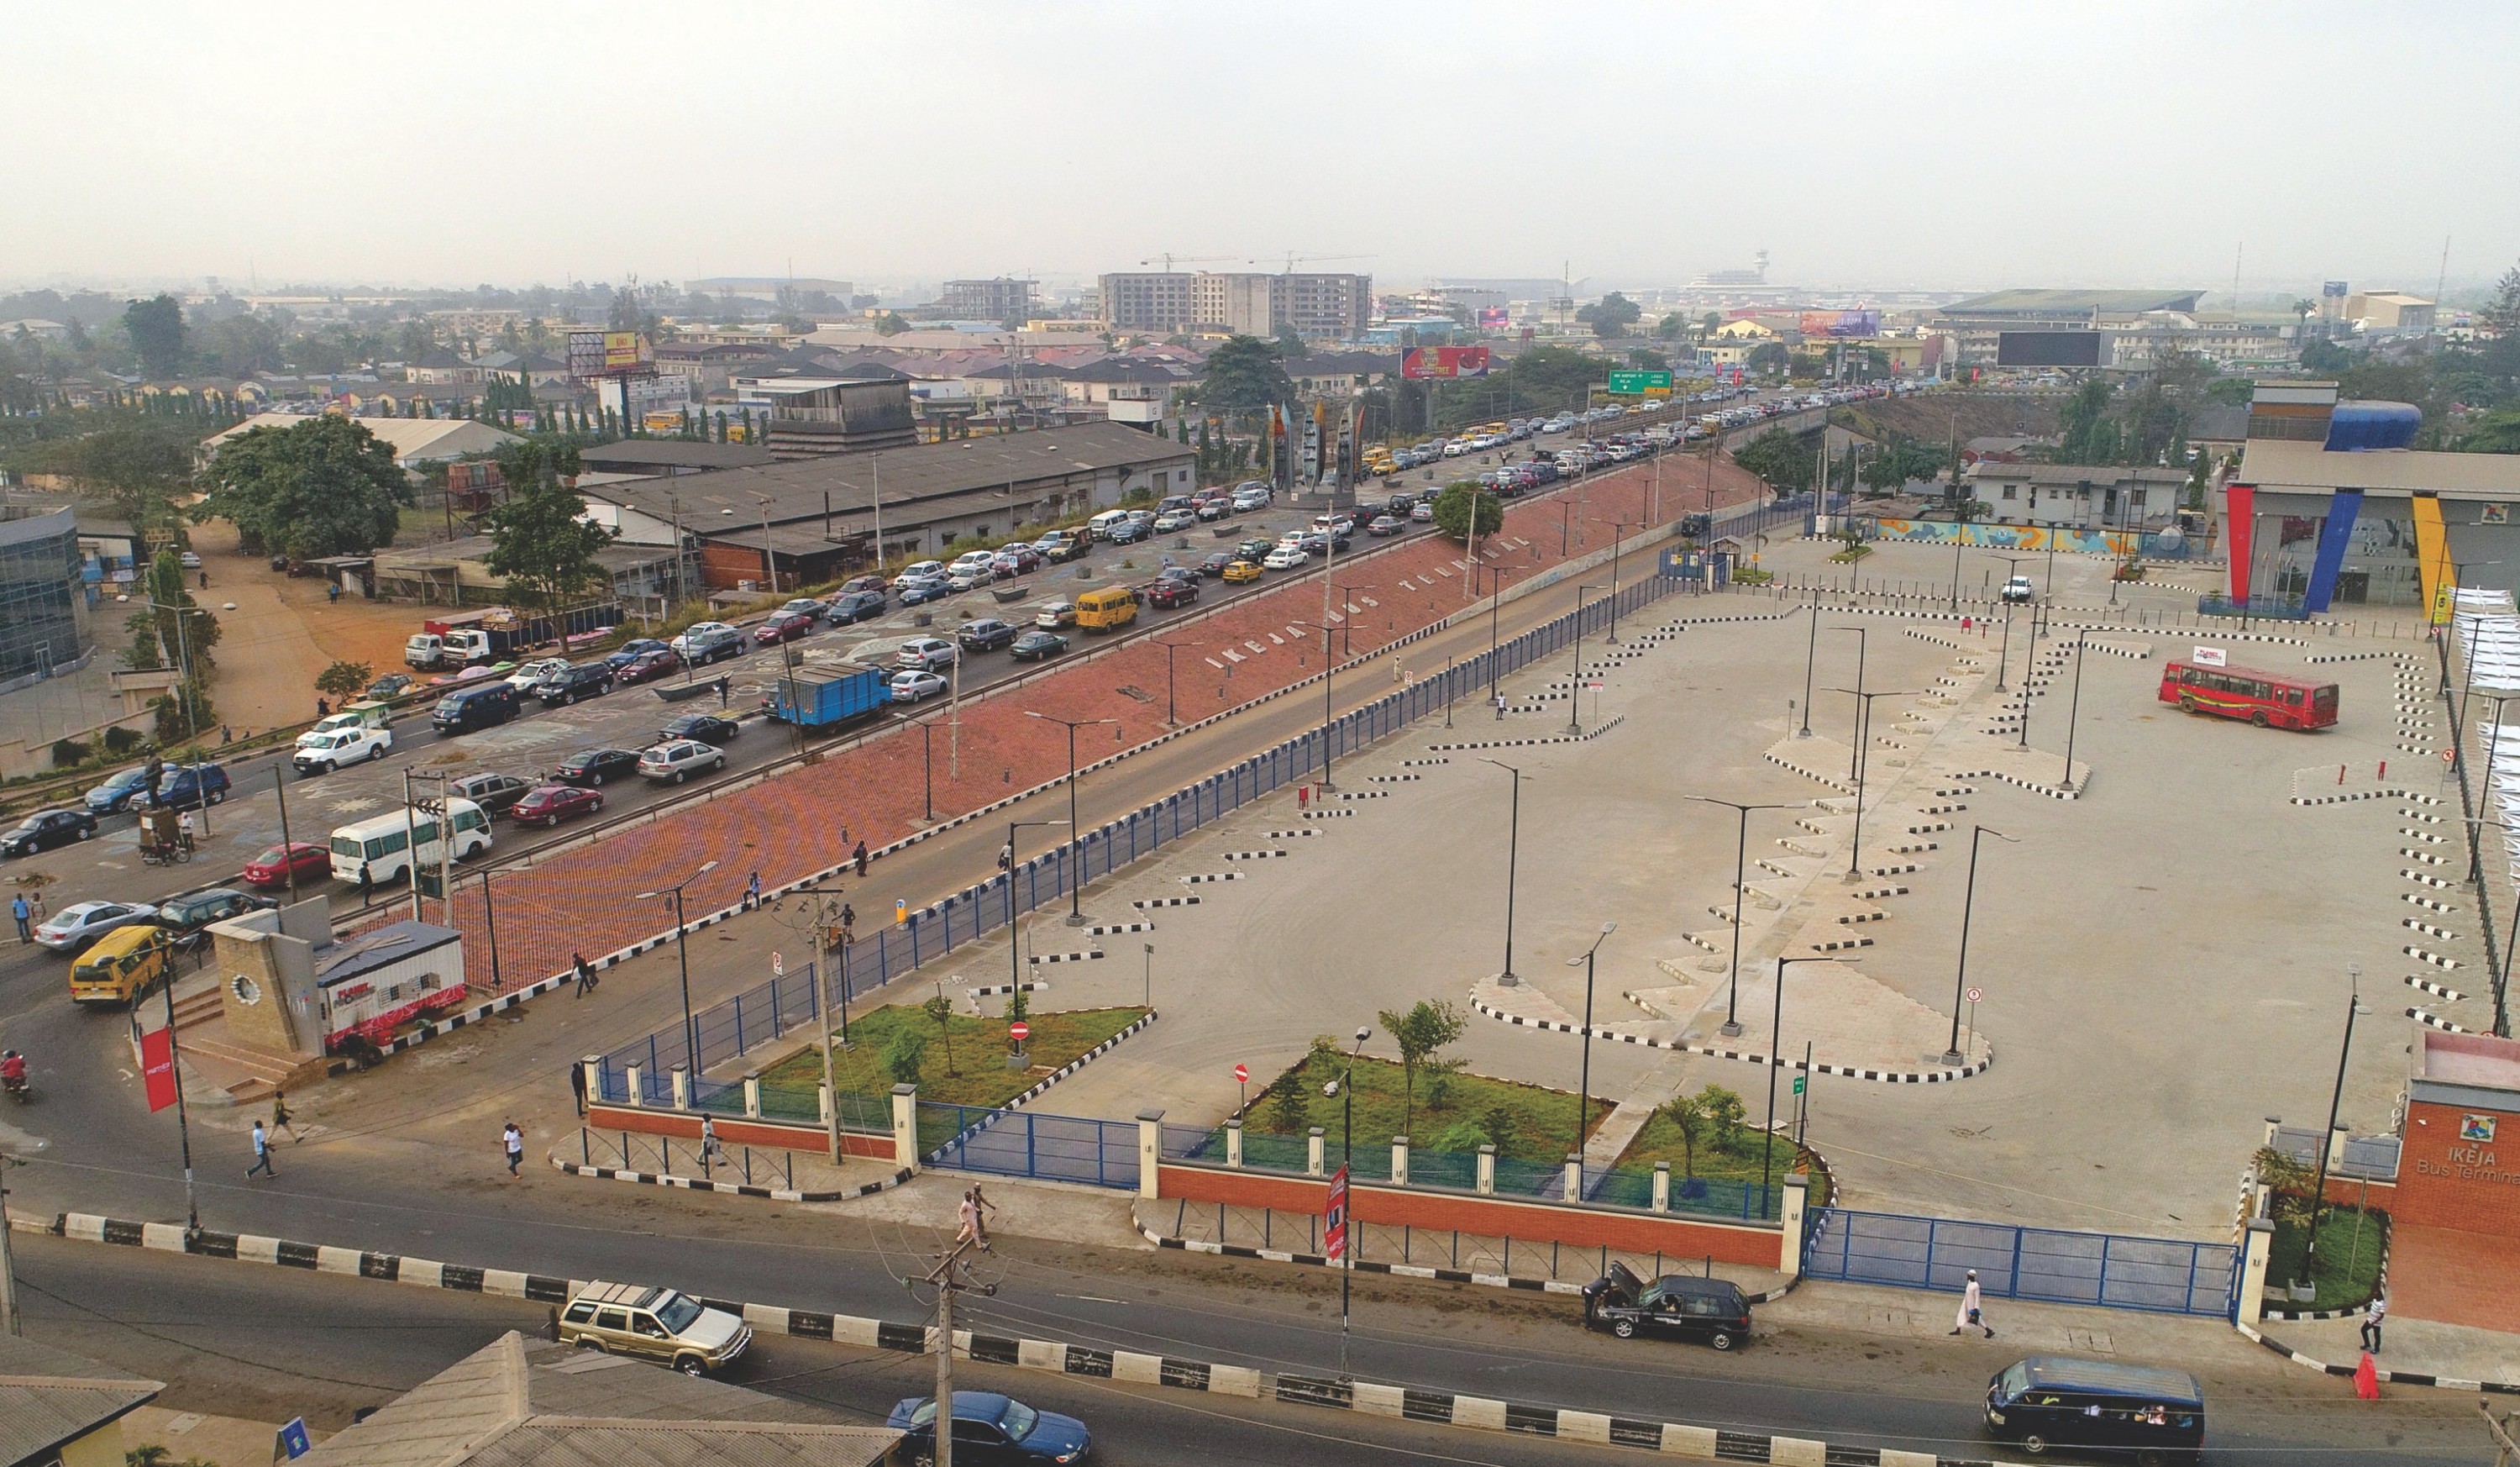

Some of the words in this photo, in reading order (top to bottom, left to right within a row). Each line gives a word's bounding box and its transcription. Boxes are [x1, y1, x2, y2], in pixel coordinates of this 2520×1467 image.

[1205, 625, 1307, 669] IKEJA
[338, 982, 370, 1000] PLANET
[2448, 1147, 2496, 1167] IKEJA
[2417, 1159, 2450, 1176] Bus
